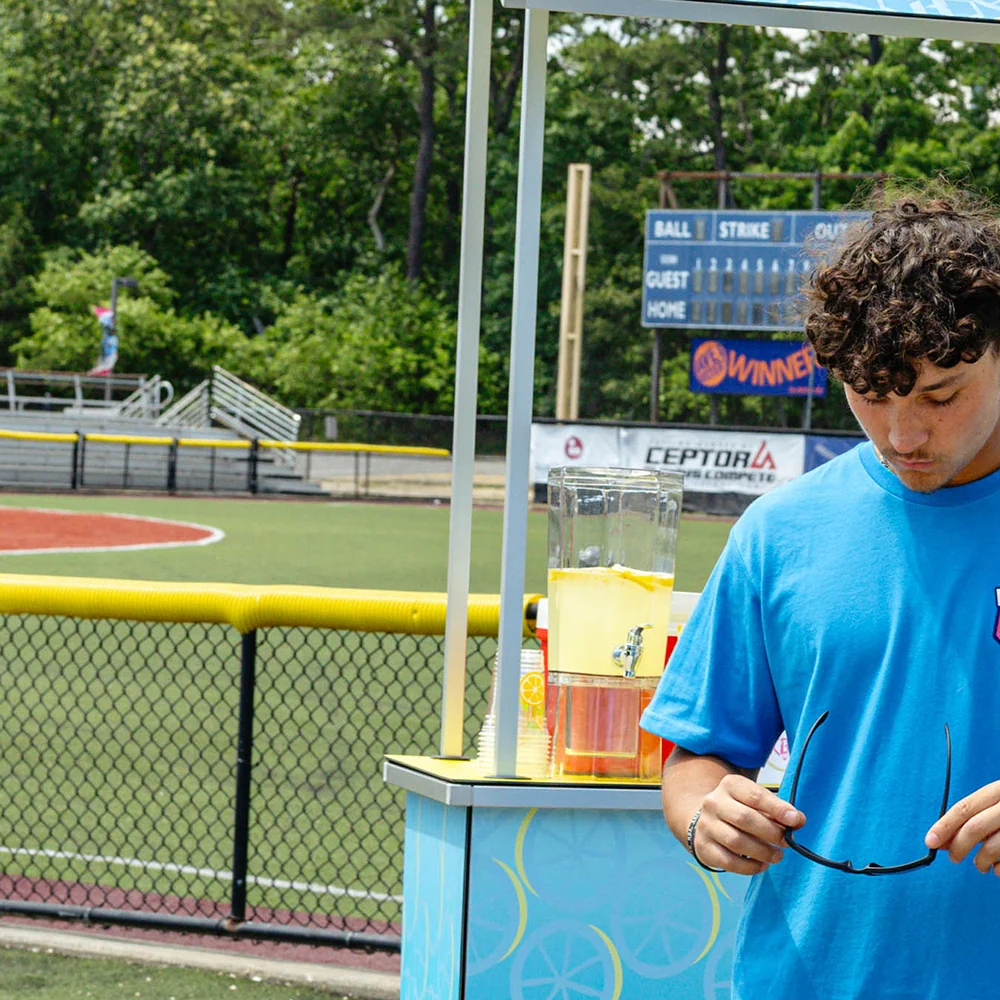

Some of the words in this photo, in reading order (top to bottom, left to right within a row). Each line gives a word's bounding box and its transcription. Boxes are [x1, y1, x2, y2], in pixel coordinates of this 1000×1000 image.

[654, 220, 692, 238] BALL
[719, 221, 770, 239] STRIKE
[645, 271, 690, 289] GUEST
[647, 301, 687, 319] HOME
